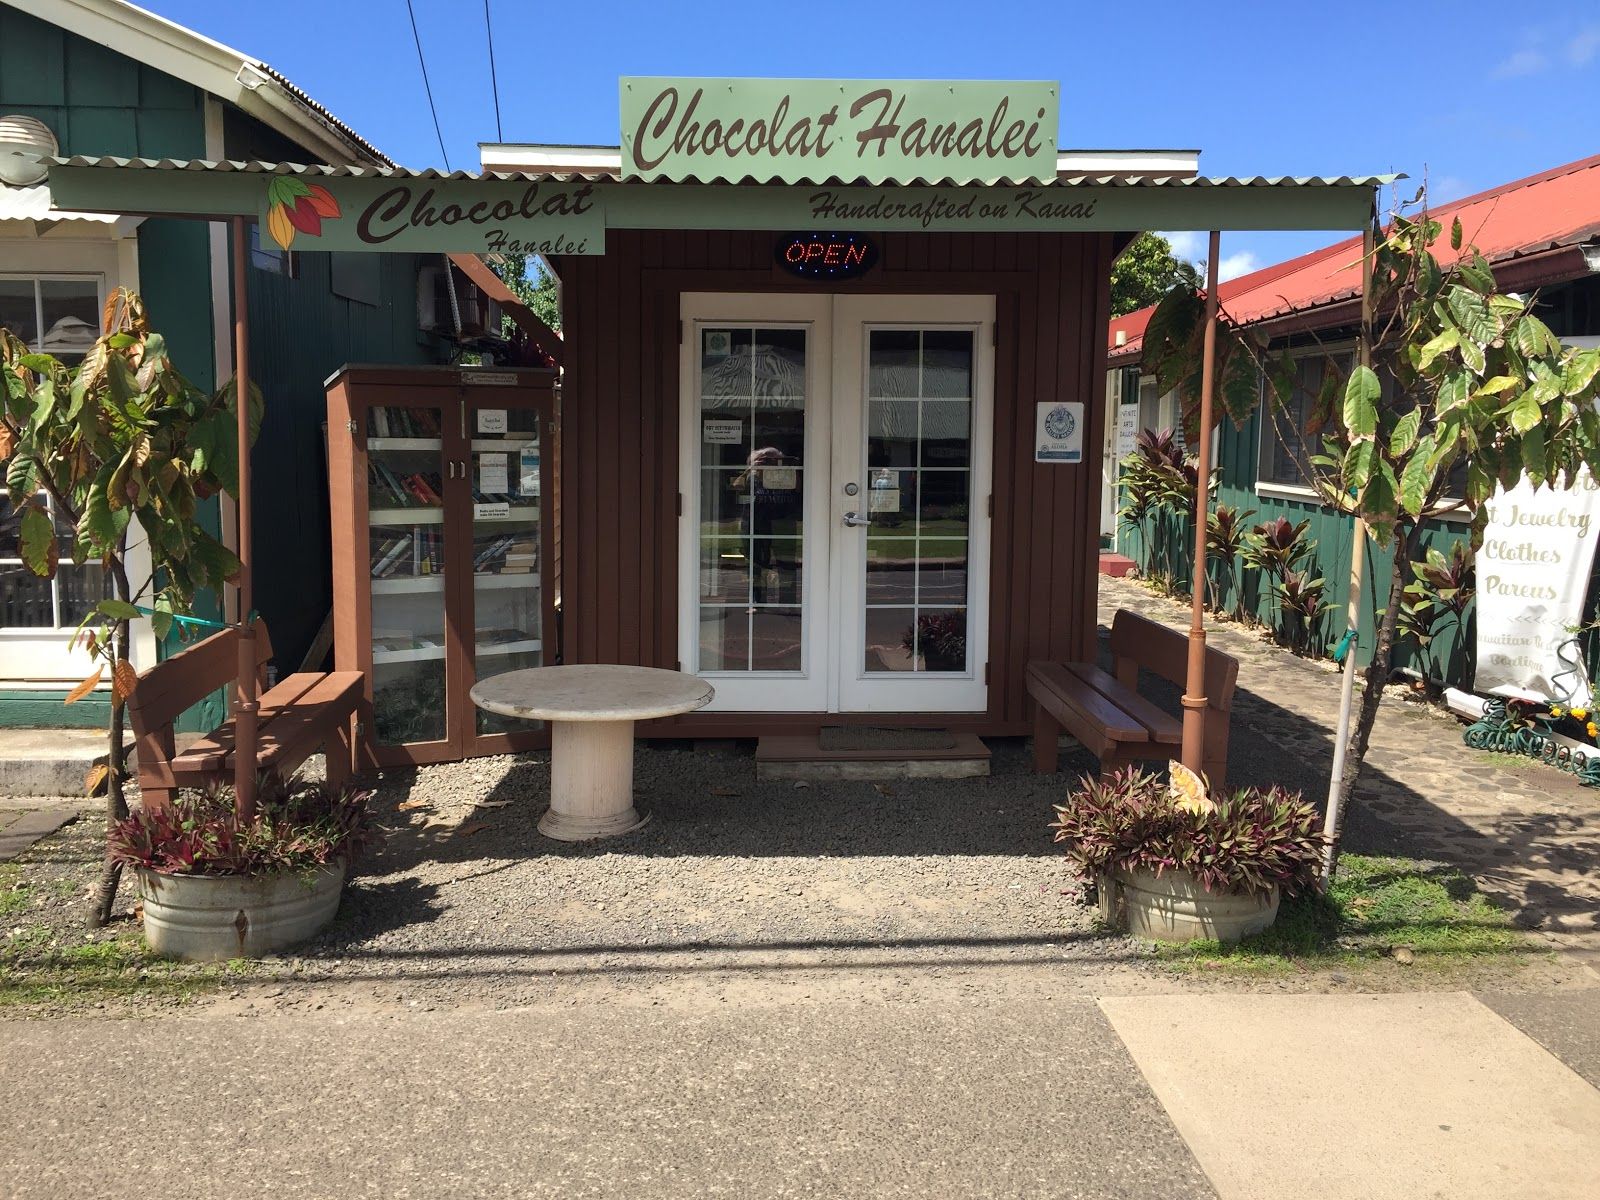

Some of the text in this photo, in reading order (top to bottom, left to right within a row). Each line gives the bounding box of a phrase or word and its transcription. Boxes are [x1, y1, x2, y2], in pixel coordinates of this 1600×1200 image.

[633, 87, 1046, 171] Chocolat Hanalei
[356, 183, 593, 244] Chocolat
[809, 191, 1098, 228] Handcrafted on Kauai
[484, 230, 588, 254] Hanalei
[785, 243, 867, 265] OPEN
[1503, 504, 1591, 538] Jewelry
[1485, 539, 1561, 564] Clothes
